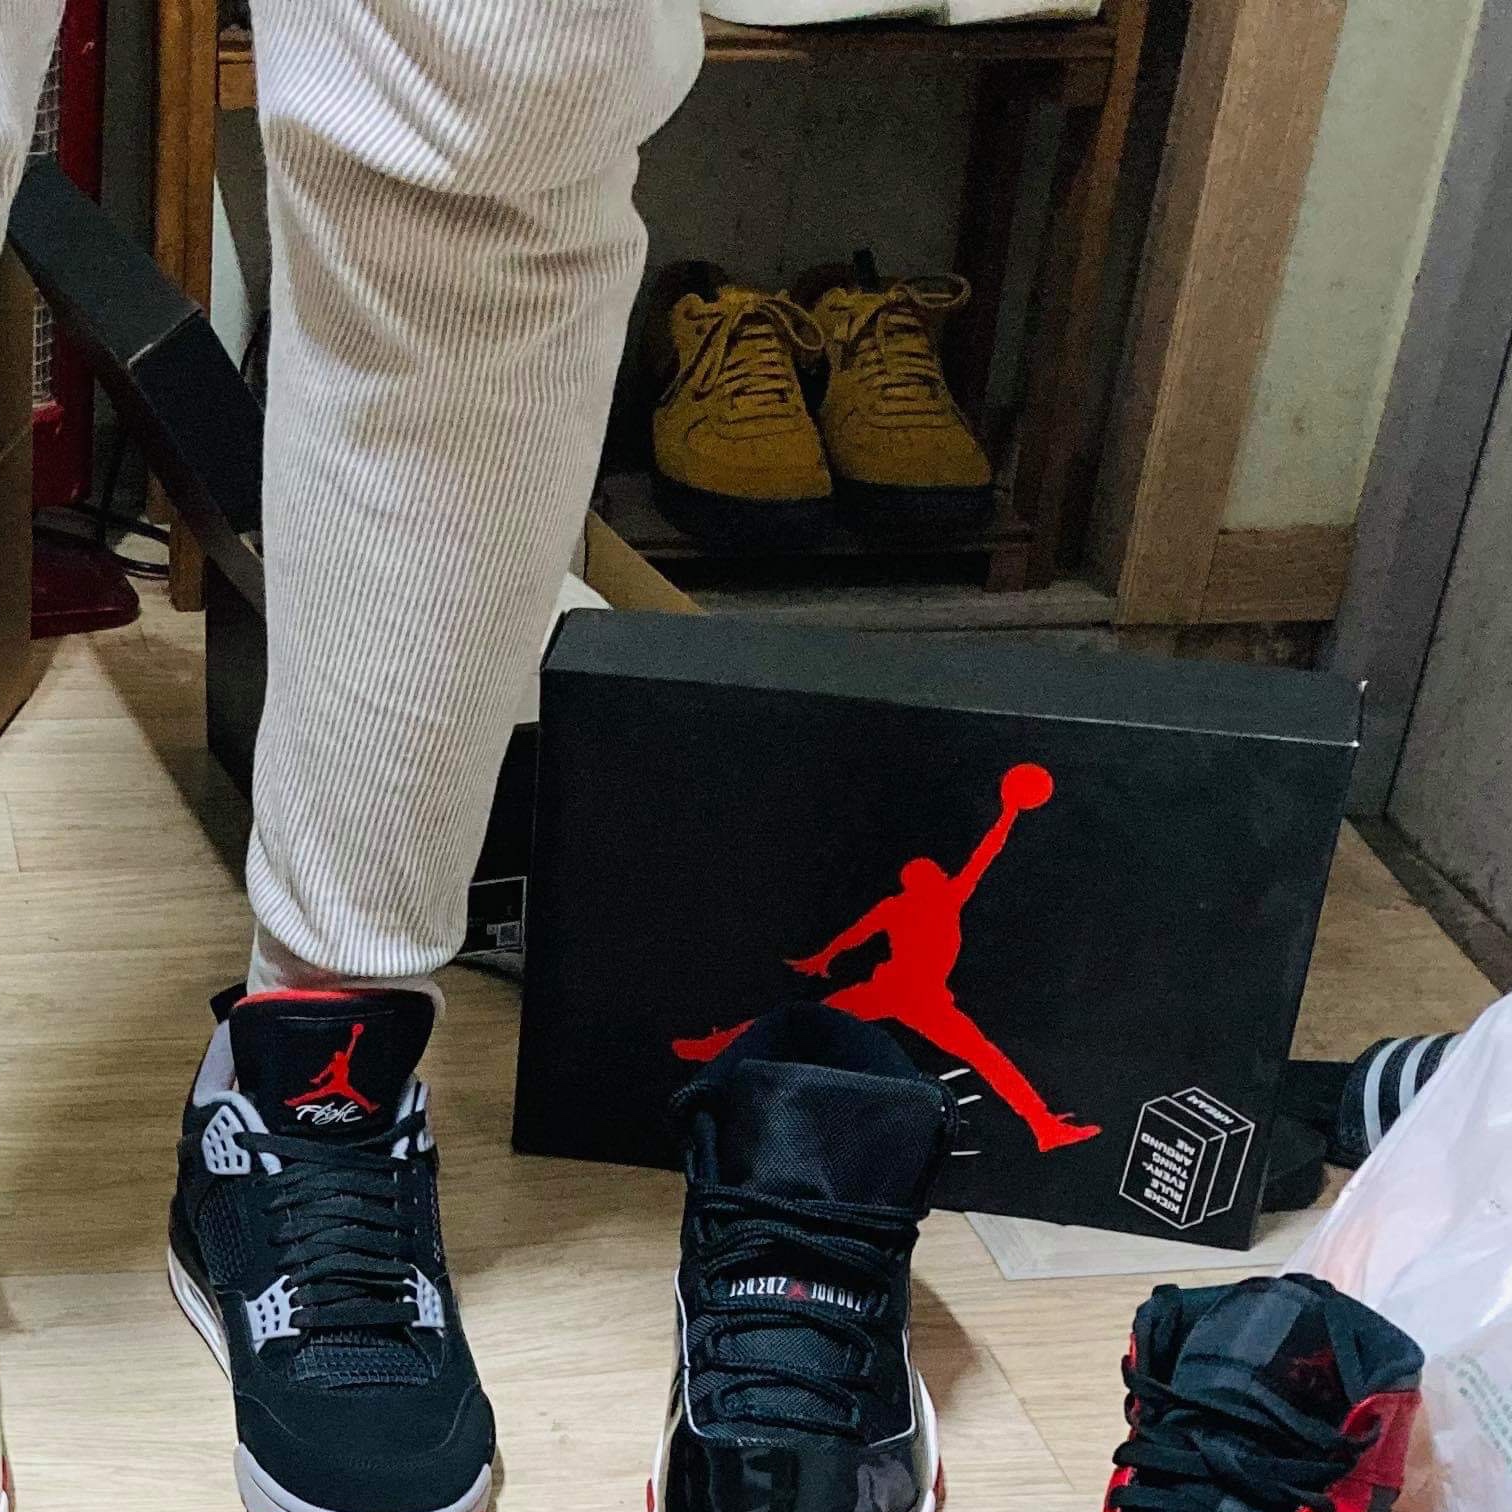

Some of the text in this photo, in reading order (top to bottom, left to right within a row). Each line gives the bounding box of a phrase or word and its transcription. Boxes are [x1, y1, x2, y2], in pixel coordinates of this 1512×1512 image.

[295, 1100, 363, 1126] Flight
[1140, 1132, 1193, 1167] AROUND
[1151, 1151, 1189, 1179] THING
[1143, 1187, 1181, 1215] KICKS
[1150, 1177, 1184, 1203] RULE
